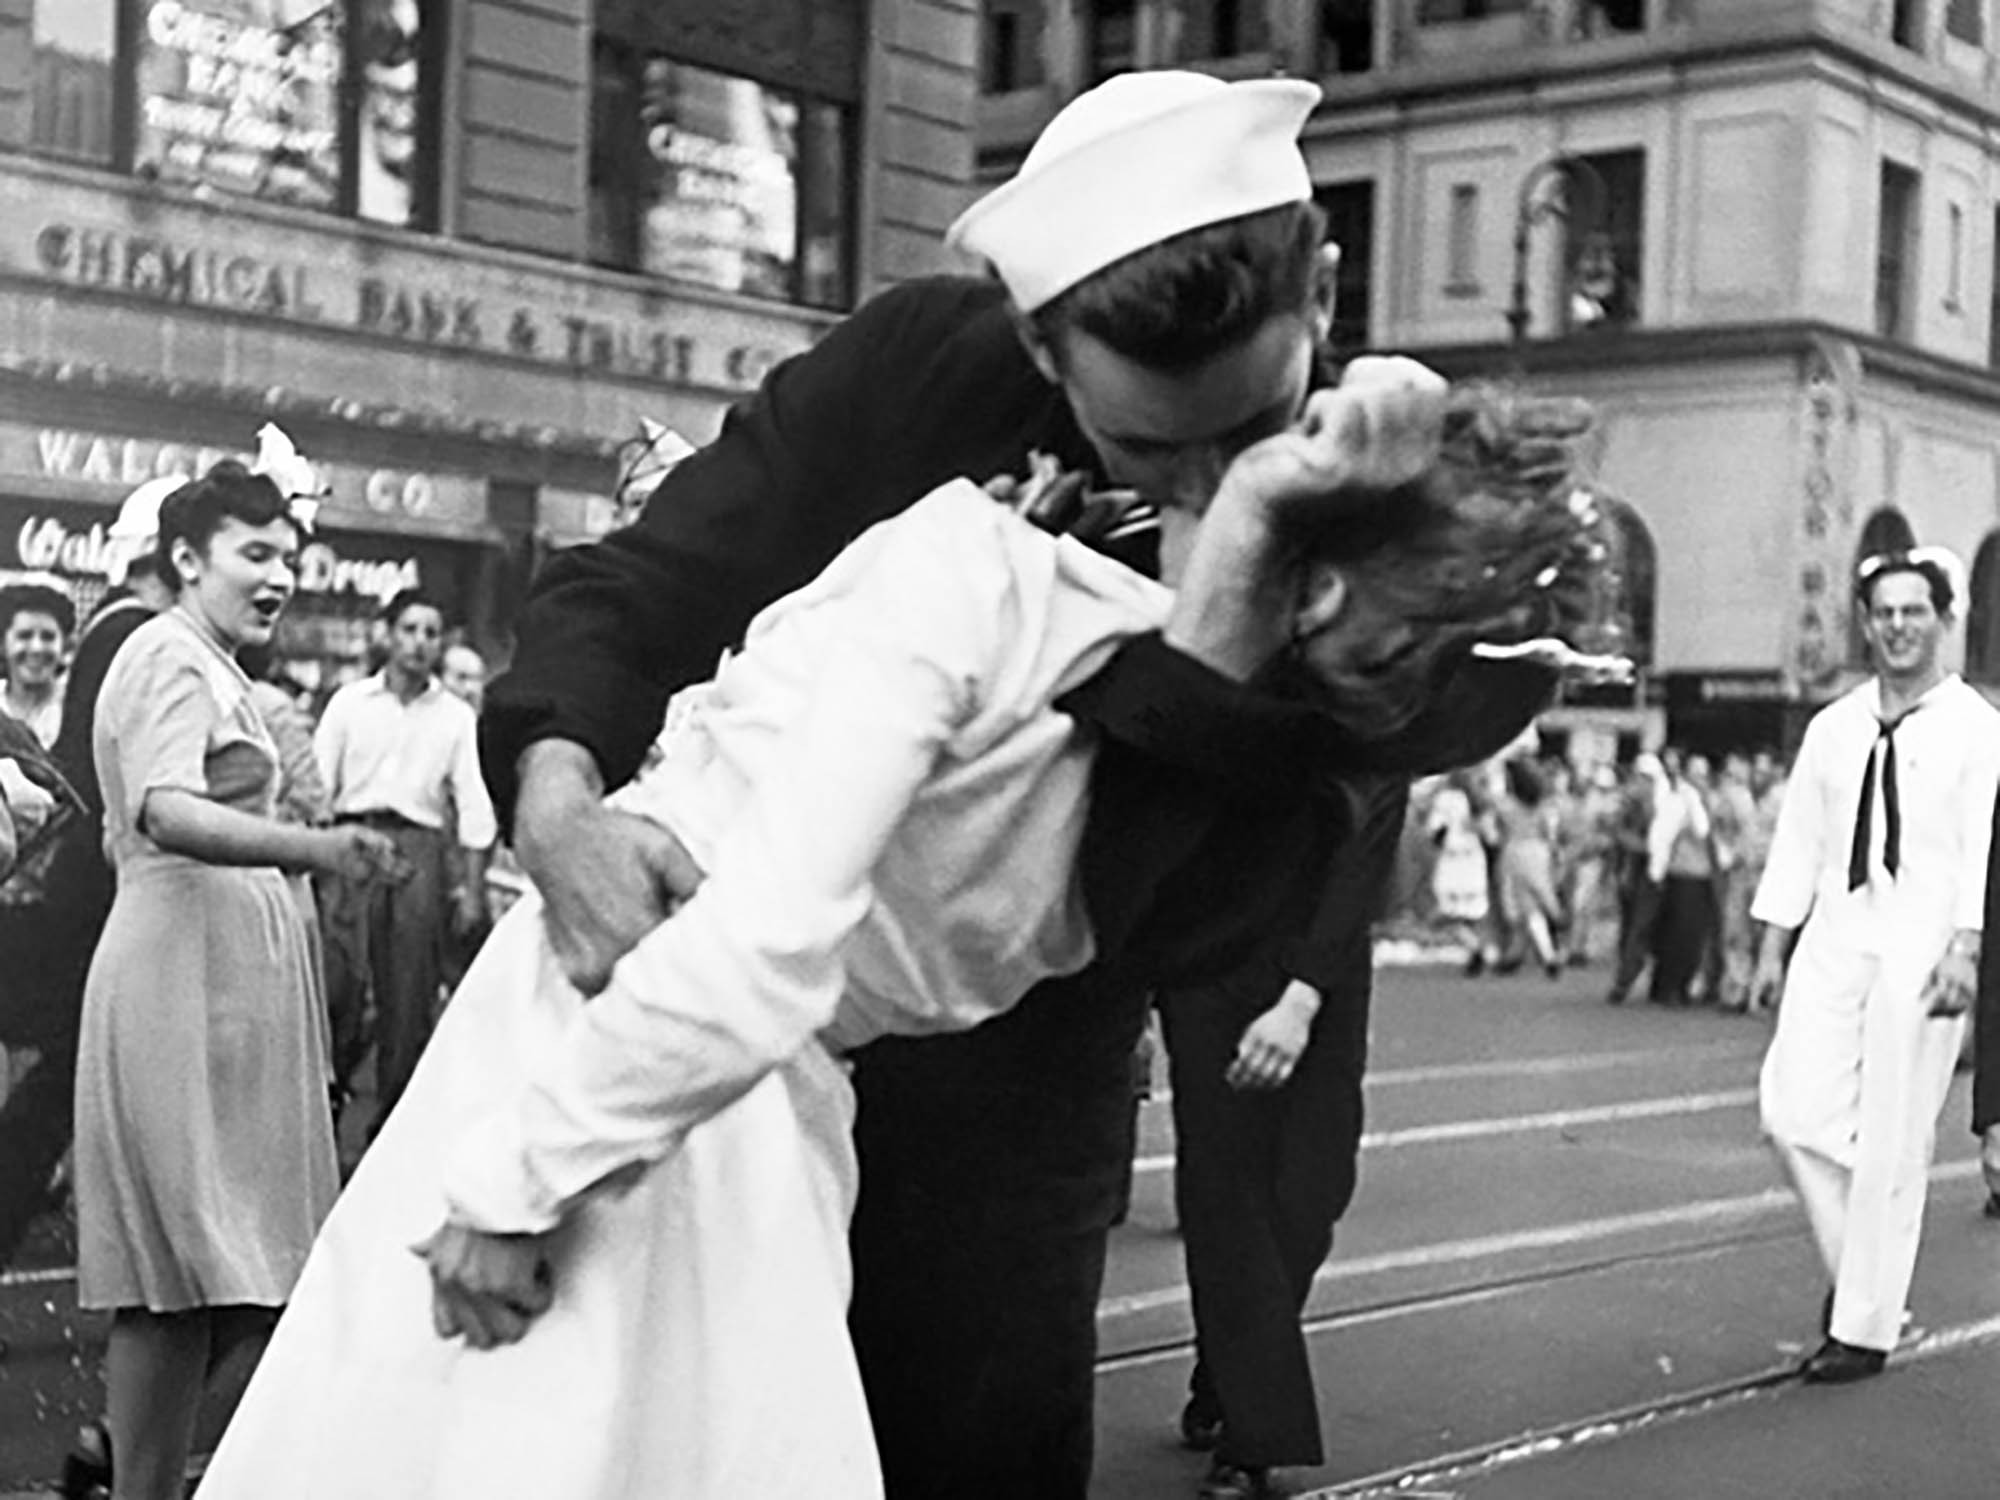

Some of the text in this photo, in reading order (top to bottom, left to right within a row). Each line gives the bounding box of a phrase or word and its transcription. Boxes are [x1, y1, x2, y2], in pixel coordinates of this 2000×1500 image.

[36, 222, 322, 319] CHEMICAL
[358, 277, 482, 345] BANK
[507, 305, 537, 354] &
[558, 313, 696, 380] TRUST
[298, 542, 421, 607] Drugs
